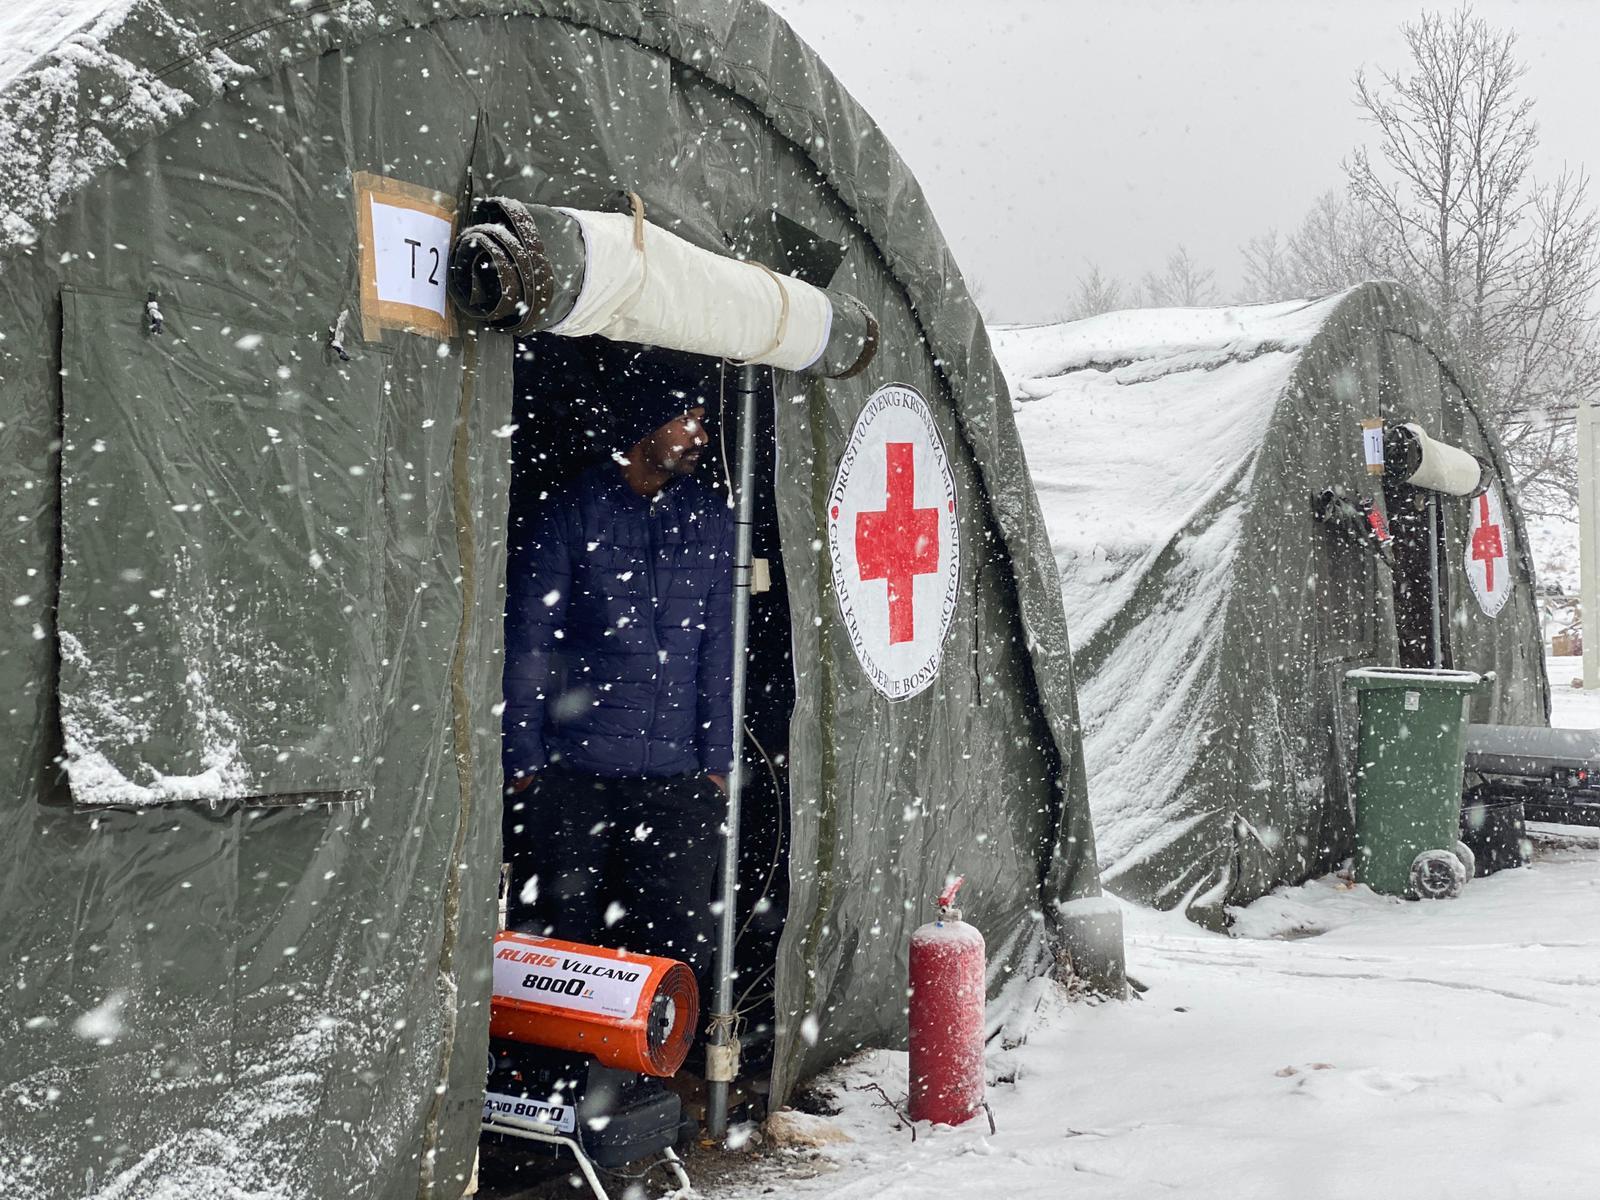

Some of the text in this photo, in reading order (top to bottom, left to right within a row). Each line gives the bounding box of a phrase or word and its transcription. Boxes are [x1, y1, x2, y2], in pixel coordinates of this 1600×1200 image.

[830, 523, 849, 602] CRVENI
[903, 654, 937, 693] BOSNE
[496, 948, 640, 983] RURIS VULCANO
[522, 973, 586, 997] 8000
